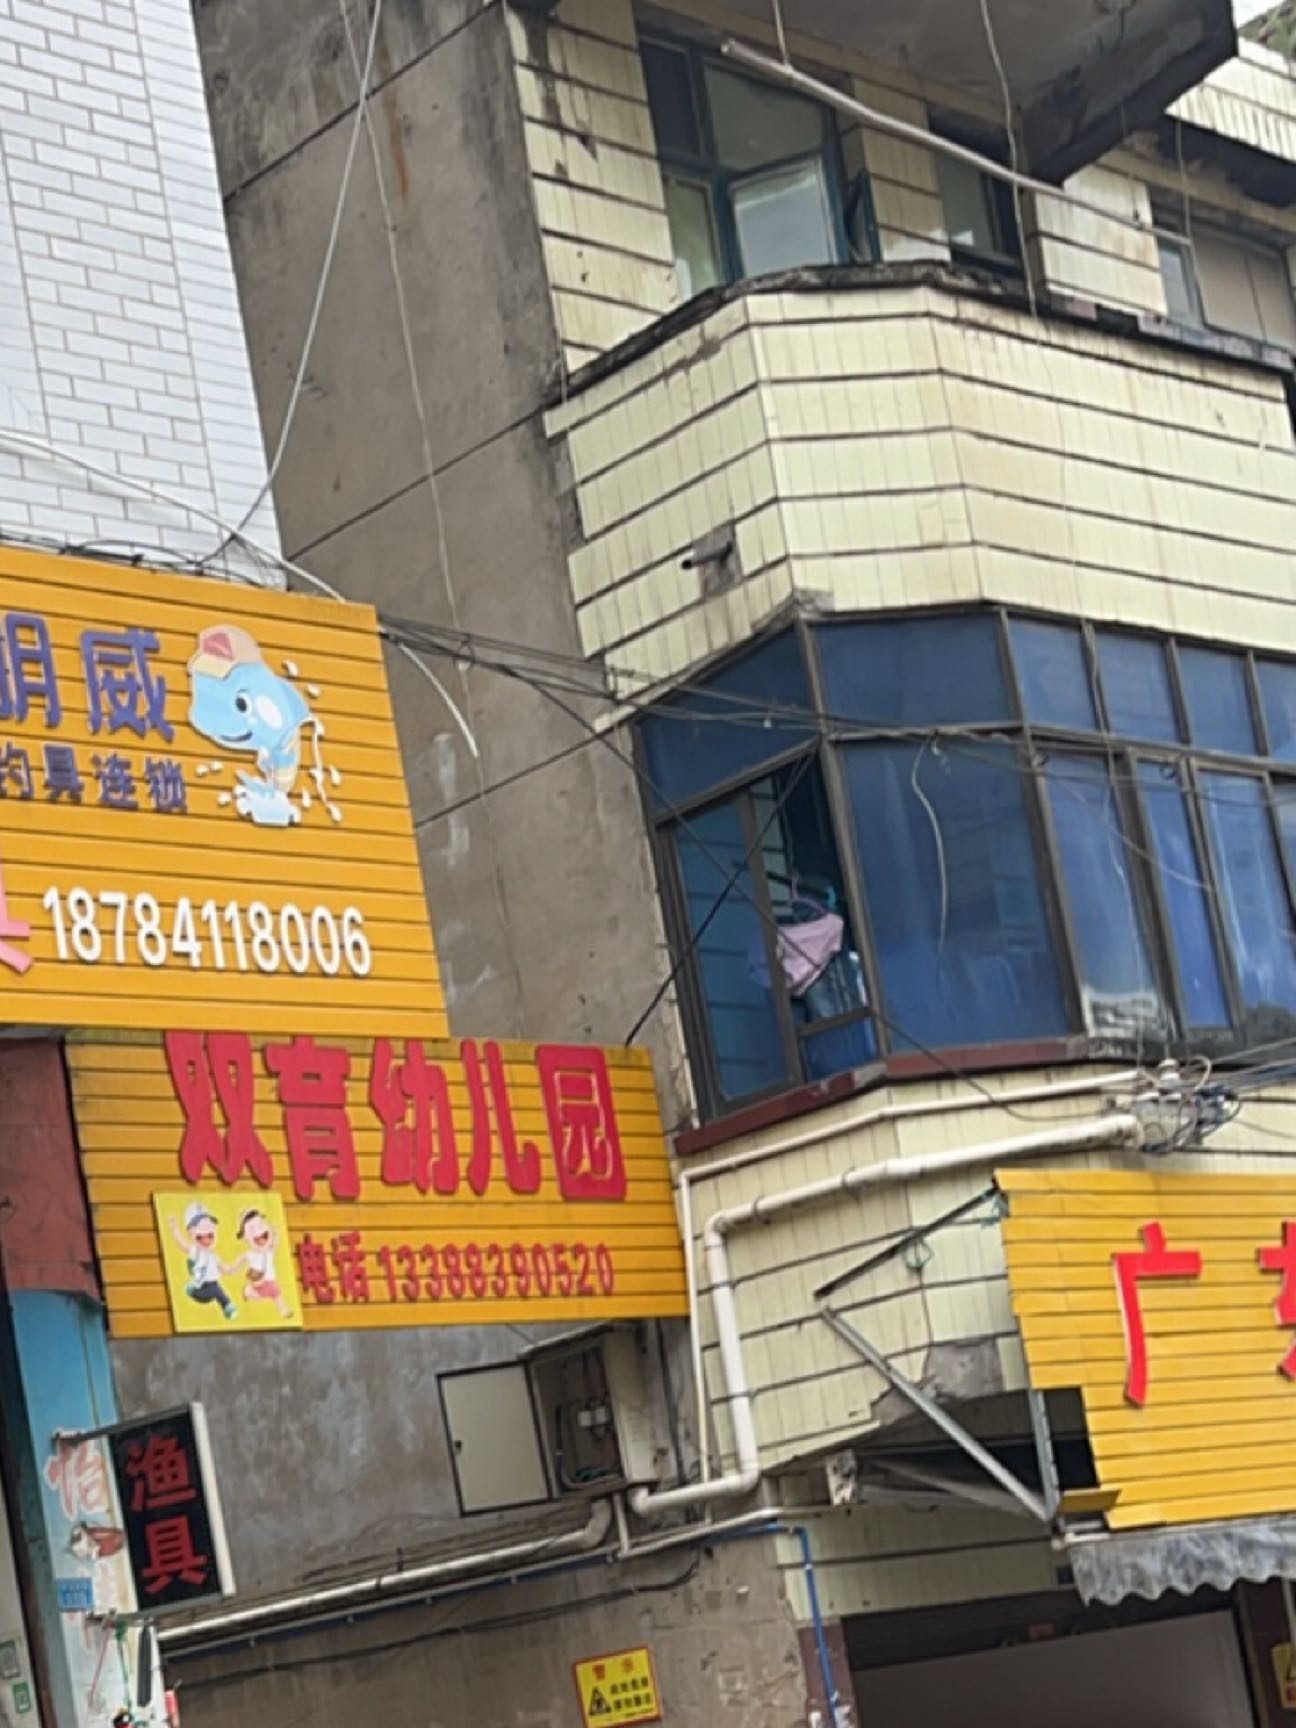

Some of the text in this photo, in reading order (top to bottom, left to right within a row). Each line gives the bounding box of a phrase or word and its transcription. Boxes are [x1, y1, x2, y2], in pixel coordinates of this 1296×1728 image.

[43, 886, 373, 977] 18784118006
[165, 1030, 627, 1200] 双育幼儿园
[126, 1432, 209, 1595] 渔具
